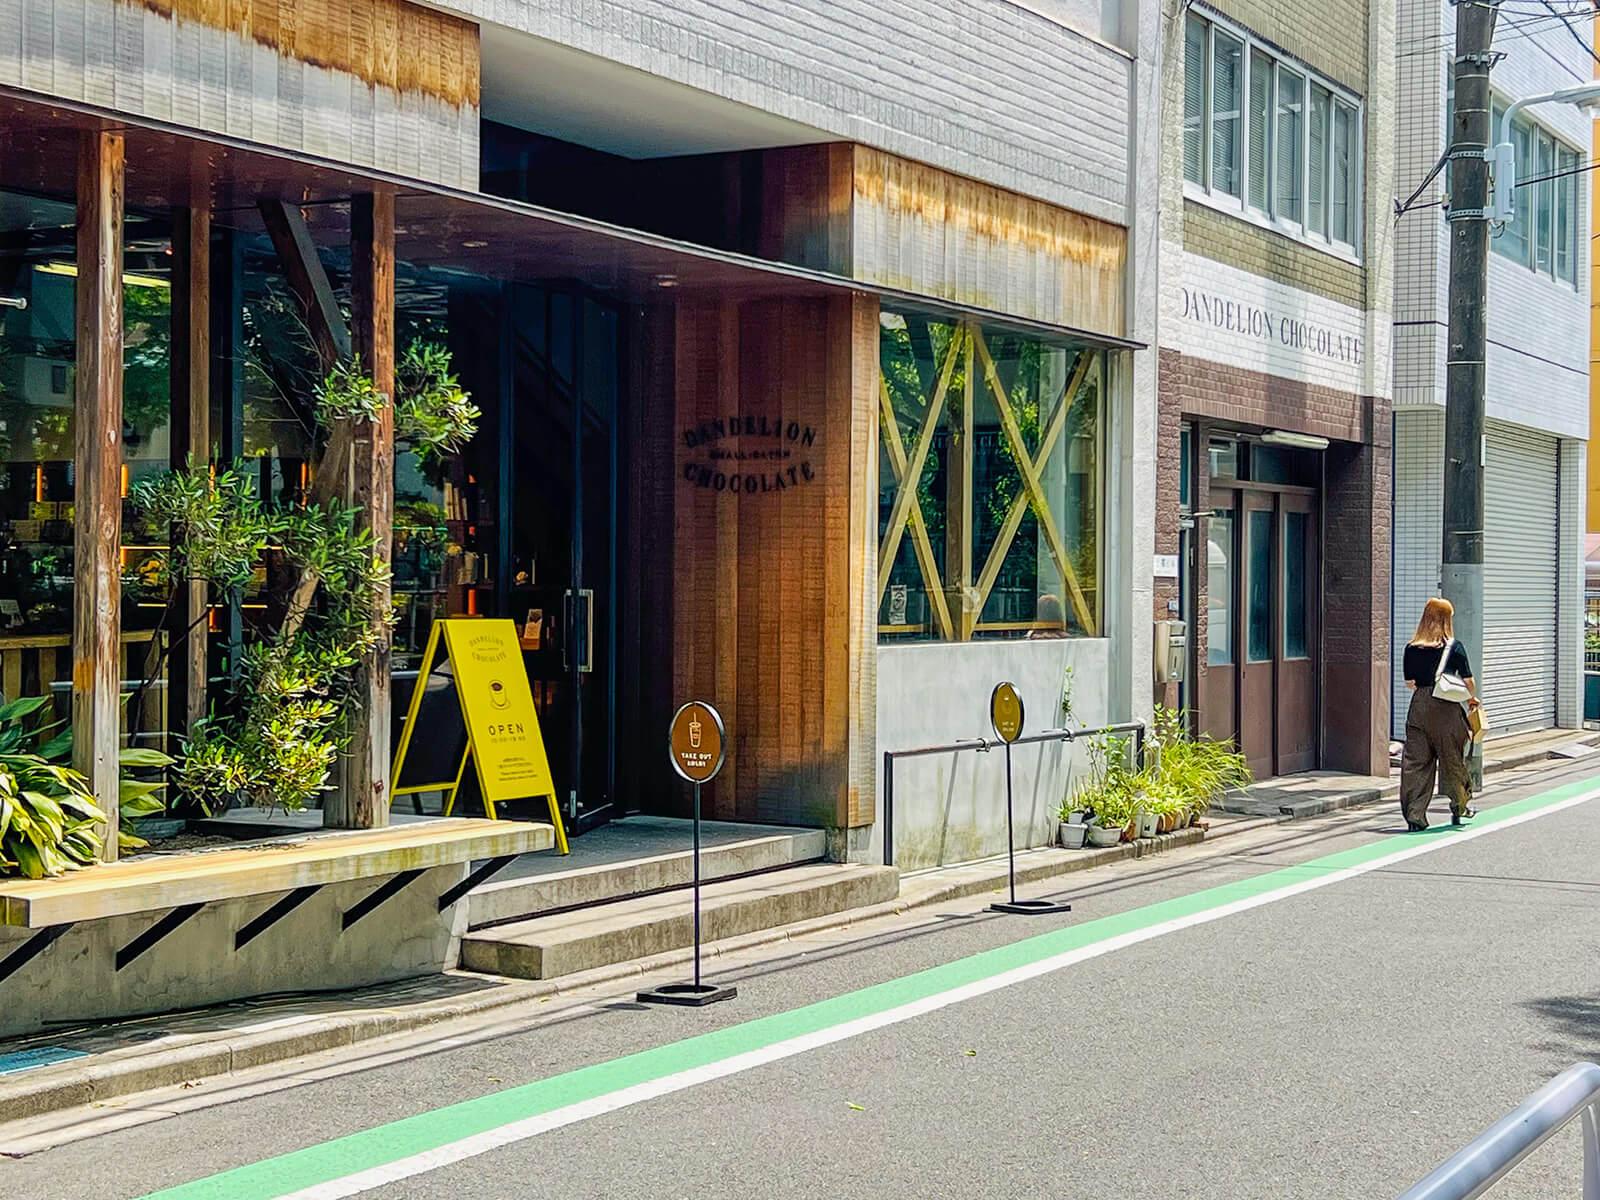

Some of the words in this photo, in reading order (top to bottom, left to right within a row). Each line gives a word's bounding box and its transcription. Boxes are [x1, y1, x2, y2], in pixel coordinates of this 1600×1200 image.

[1280, 316, 1361, 365] CHOCOLATE
[684, 416, 817, 447] DANDELION
[684, 461, 816, 493] CHOCOLATE
[487, 722, 524, 736] OPEN
